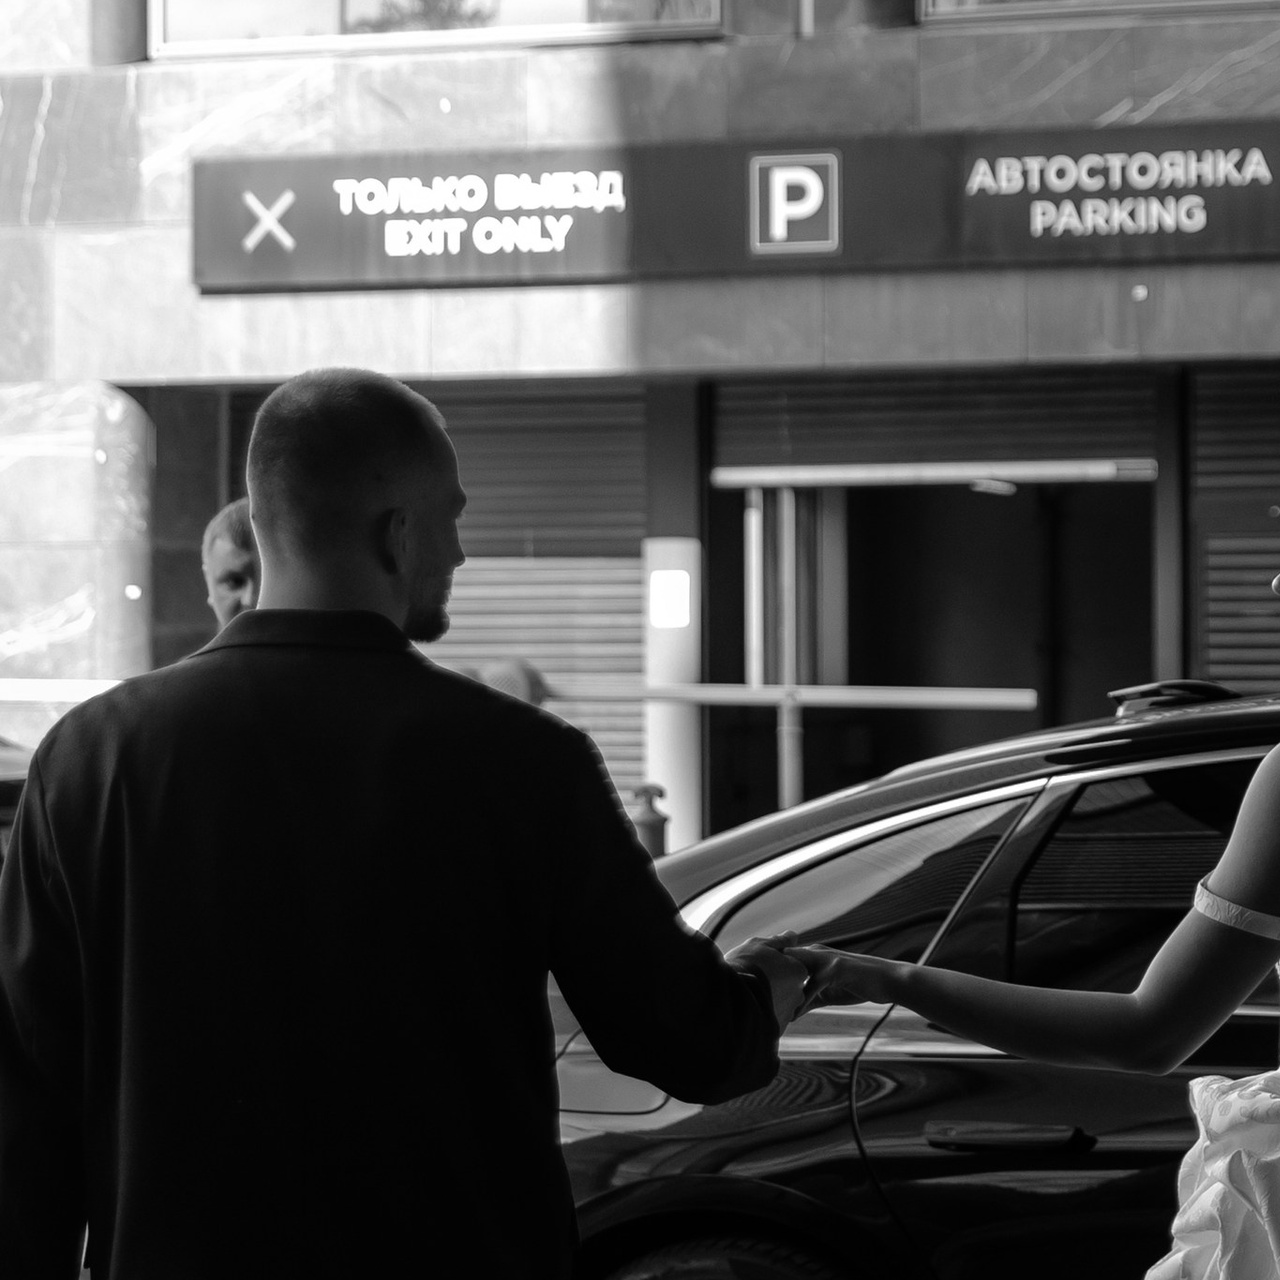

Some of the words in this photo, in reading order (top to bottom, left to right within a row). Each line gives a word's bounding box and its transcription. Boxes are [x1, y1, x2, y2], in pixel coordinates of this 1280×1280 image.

[965, 147, 1273, 197] АВТОСТОЯНКА
[333, 174, 488, 215] ТОЛЬКО
[769, 165, 824, 242] P
[384, 218, 468, 256] EXIT
[472, 215, 574, 254] ONLY
[1029, 195, 1208, 238] PARKING
